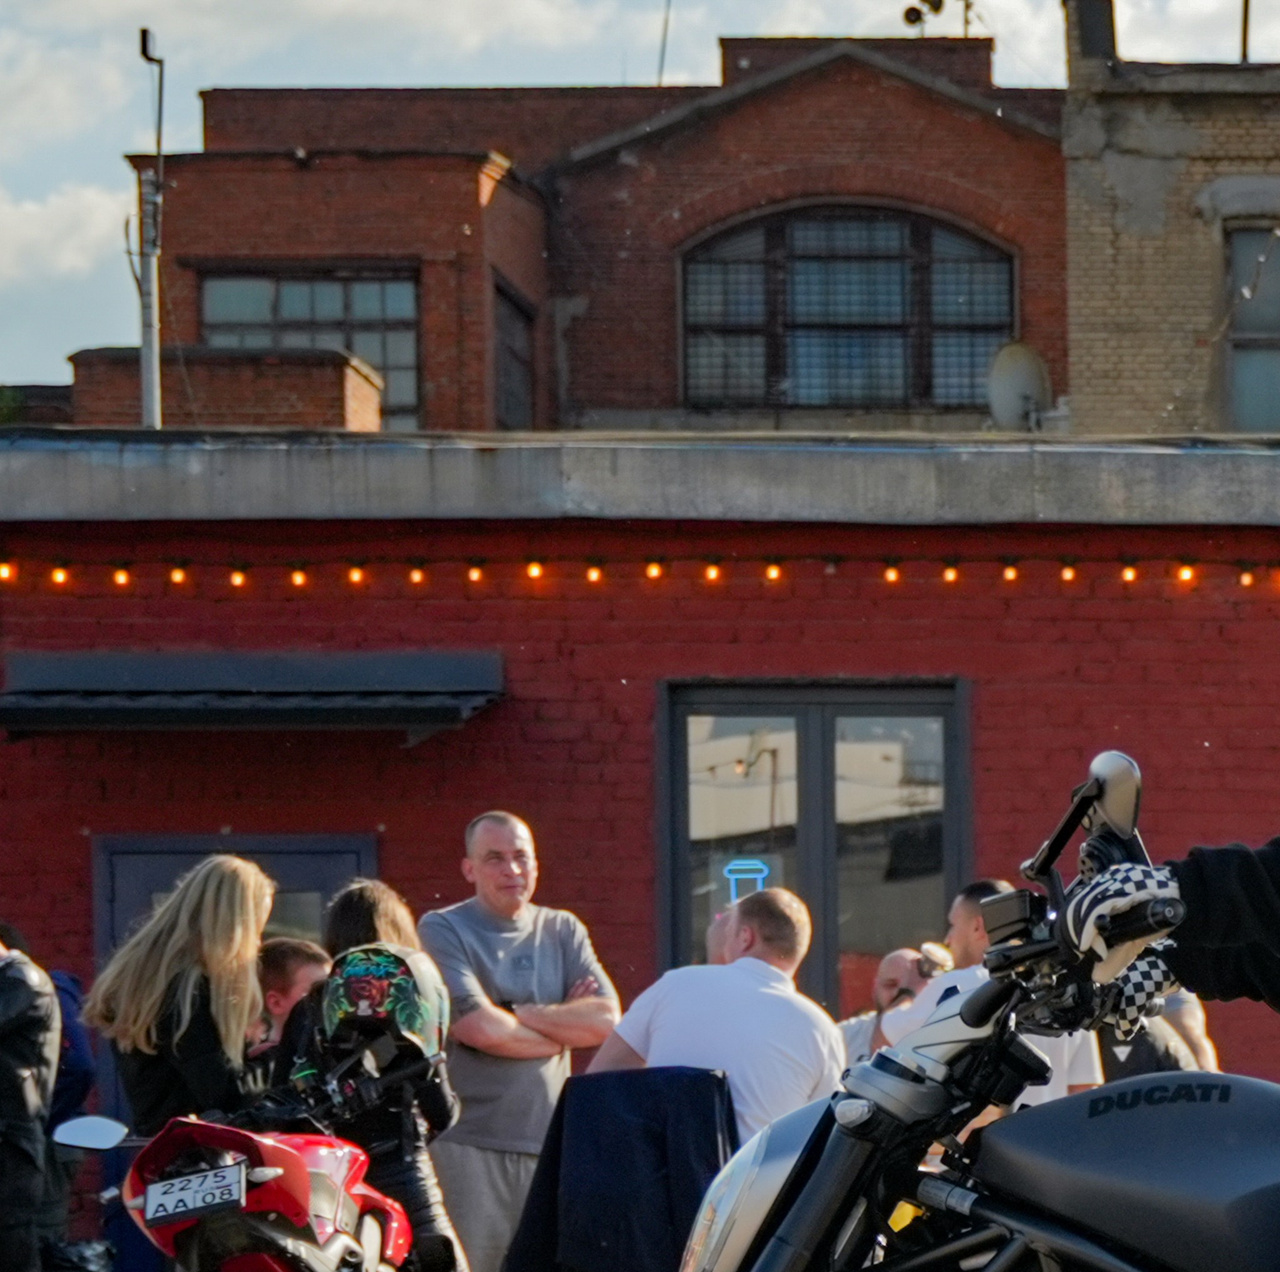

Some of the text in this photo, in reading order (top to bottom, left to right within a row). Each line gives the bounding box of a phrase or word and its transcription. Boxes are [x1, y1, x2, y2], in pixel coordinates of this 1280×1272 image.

[1088, 1083, 1232, 1119] DUCATI
[161, 1169, 227, 1196] 2275
[202, 1188, 234, 1205] 08
